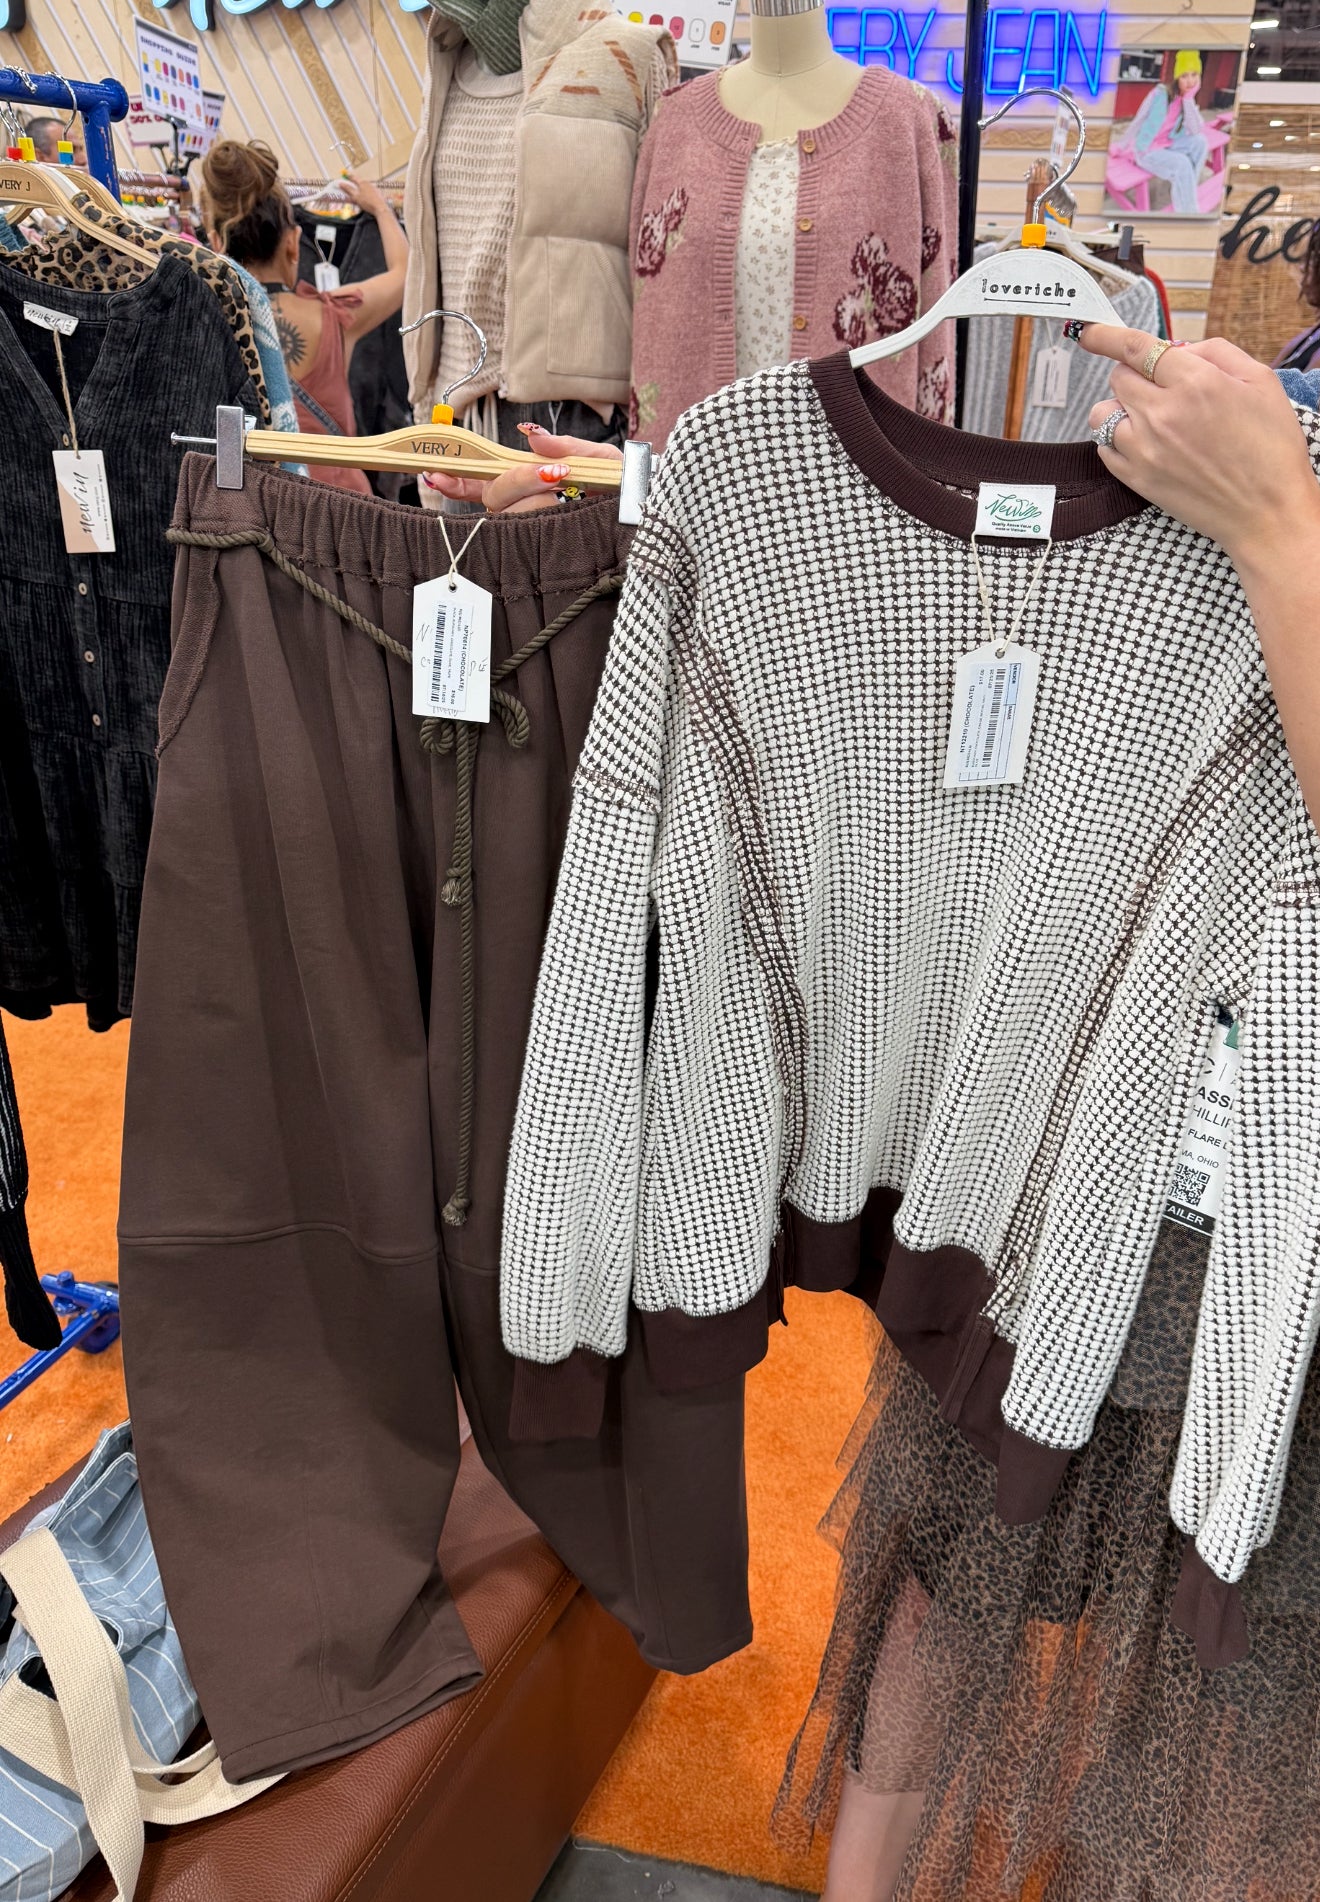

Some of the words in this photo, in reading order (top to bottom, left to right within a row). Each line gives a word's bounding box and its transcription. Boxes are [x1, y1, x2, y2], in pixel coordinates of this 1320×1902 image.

[826, 8, 936, 80] ERY
[26, 182, 31, 192] J
[981, 278, 1077, 298] loveriche
[411, 441, 450, 455] VERY
[454, 444, 462, 456] J
[1197, 1086, 1235, 1111] ASS
[1187, 1128, 1222, 1148] FLARE
[1197, 1155, 1220, 1169] OHIO
